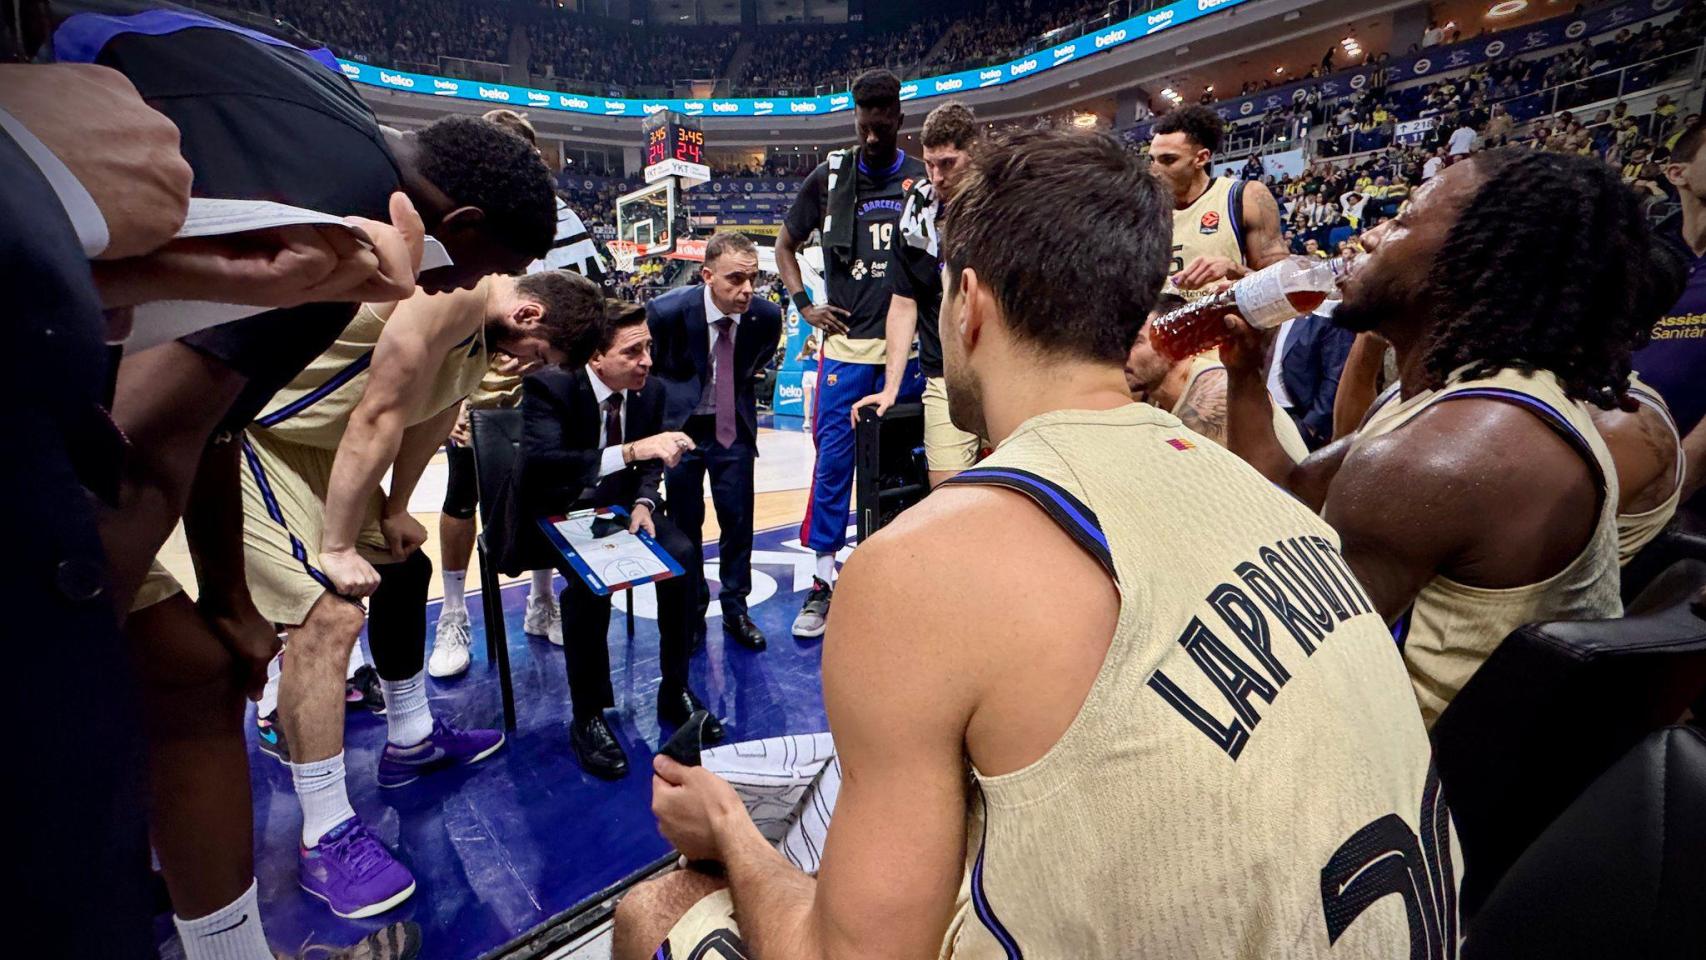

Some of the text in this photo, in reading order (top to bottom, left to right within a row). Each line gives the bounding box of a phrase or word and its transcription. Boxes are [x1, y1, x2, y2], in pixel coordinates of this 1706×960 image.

[380, 71, 415, 88] beko
[434, 79, 458, 91] beko
[479, 87, 510, 101] beko
[527, 91, 551, 102] beko
[560, 96, 589, 109] beko
[605, 100, 625, 110] beko
[684, 101, 704, 111] beko
[712, 102, 739, 112] beko
[754, 101, 774, 110] beko
[791, 101, 816, 113] beko
[831, 96, 849, 106] beko
[936, 78, 963, 91] beko
[980, 69, 1002, 80] beko
[1011, 59, 1037, 76] beko
[1054, 44, 1076, 58] beko
[1095, 29, 1127, 48] beko
[1148, 9, 1174, 25] beko
[650, 126, 666, 145] 3:45
[678, 127, 703, 145] 3:45
[649, 143, 664, 165] 24
[676, 142, 699, 163] 24
[672, 162, 689, 173] YKT
[869, 223, 893, 250] 19
[779, 384, 802, 398] beko
